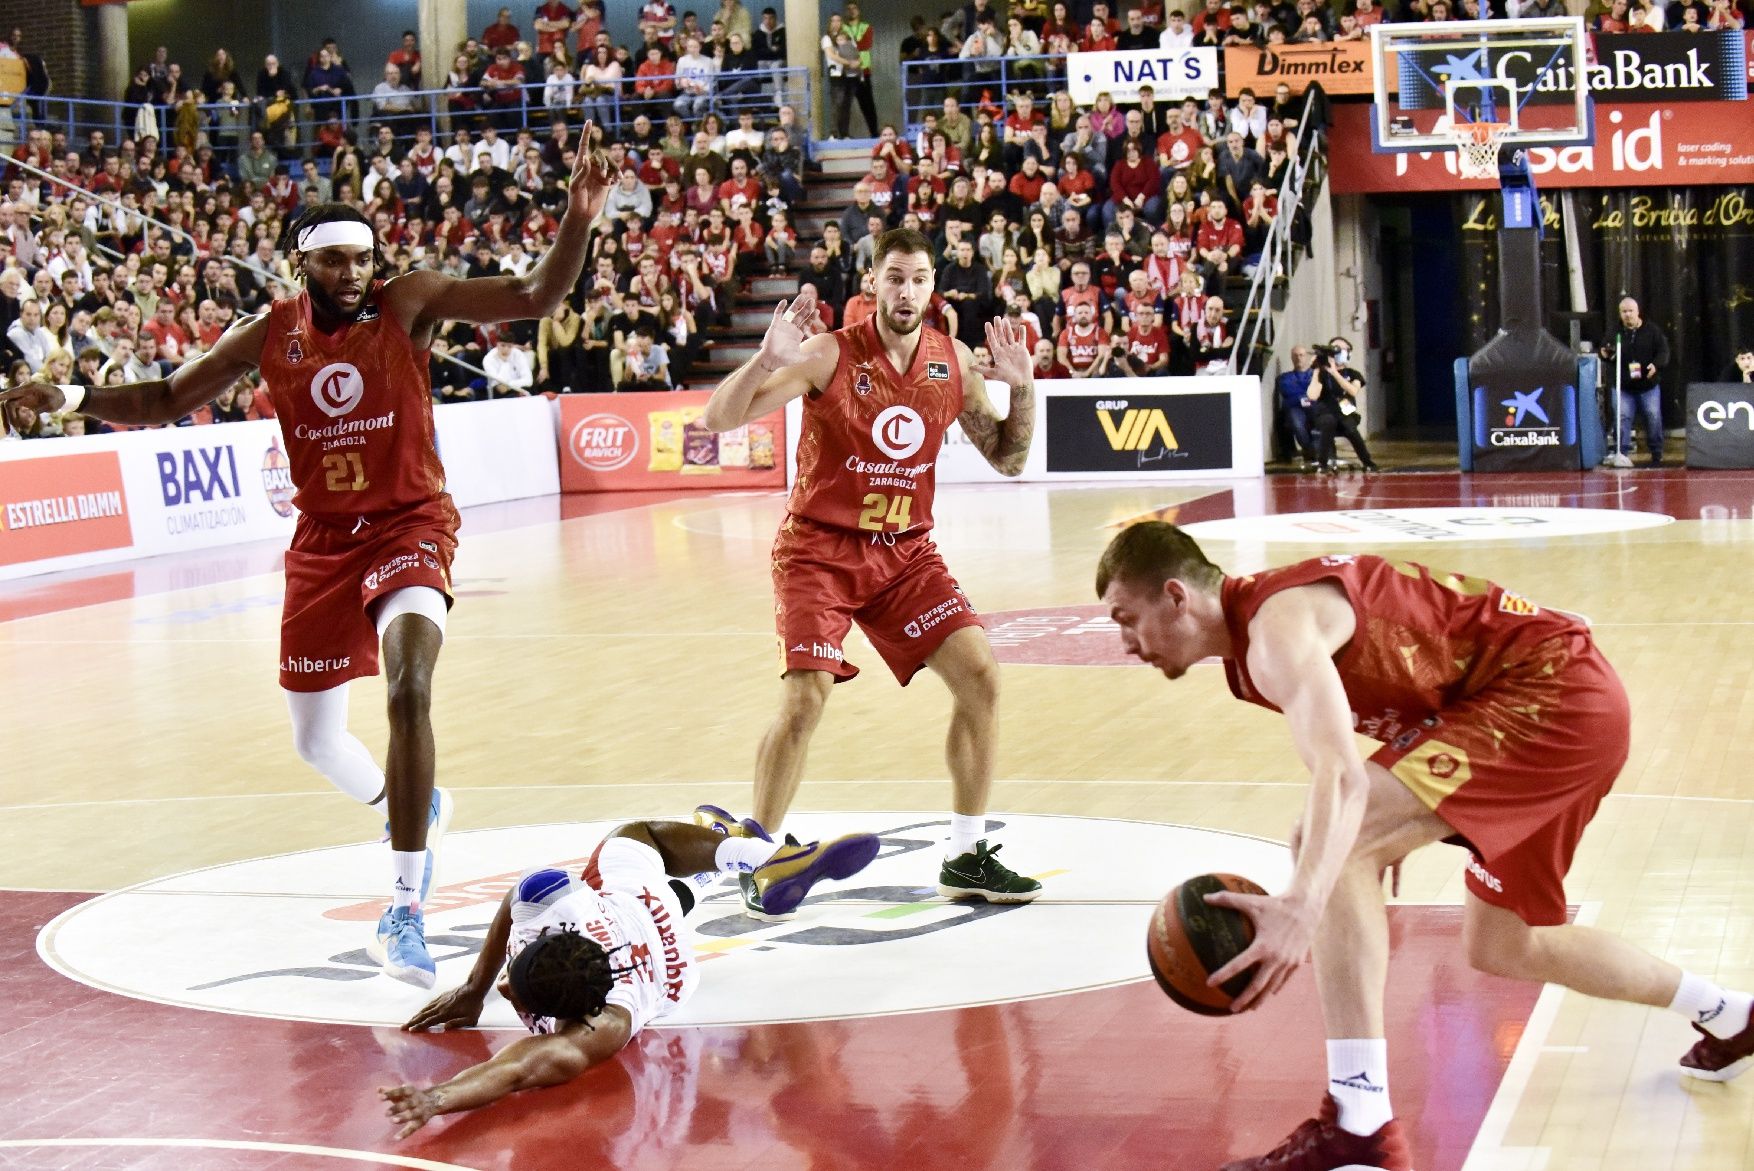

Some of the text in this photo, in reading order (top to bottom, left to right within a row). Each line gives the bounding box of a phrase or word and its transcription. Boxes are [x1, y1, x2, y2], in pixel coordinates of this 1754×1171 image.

[1609, 109, 1663, 172] id
[1677, 142, 1732, 154] laser coding
[1678, 155, 1687, 166] &
[1688, 156, 1728, 168] marking
[1095, 400, 1129, 411] GRUP
[294, 410, 395, 440] Casademont
[579, 427, 629, 448] FRIT
[1096, 408, 1179, 451] VIA
[1491, 431, 1560, 446] CaixaBank
[156, 445, 242, 507] BAXI
[322, 452, 370, 491] 21
[869, 477, 917, 490] ZARAGOZA
[7, 491, 123, 531] ESTRELLA DAMM
[858, 493, 913, 533] 24
[379, 552, 419, 576] Zaragoza
[918, 597, 959, 624] Zaragoza
[288, 655, 351, 673] hiberus
